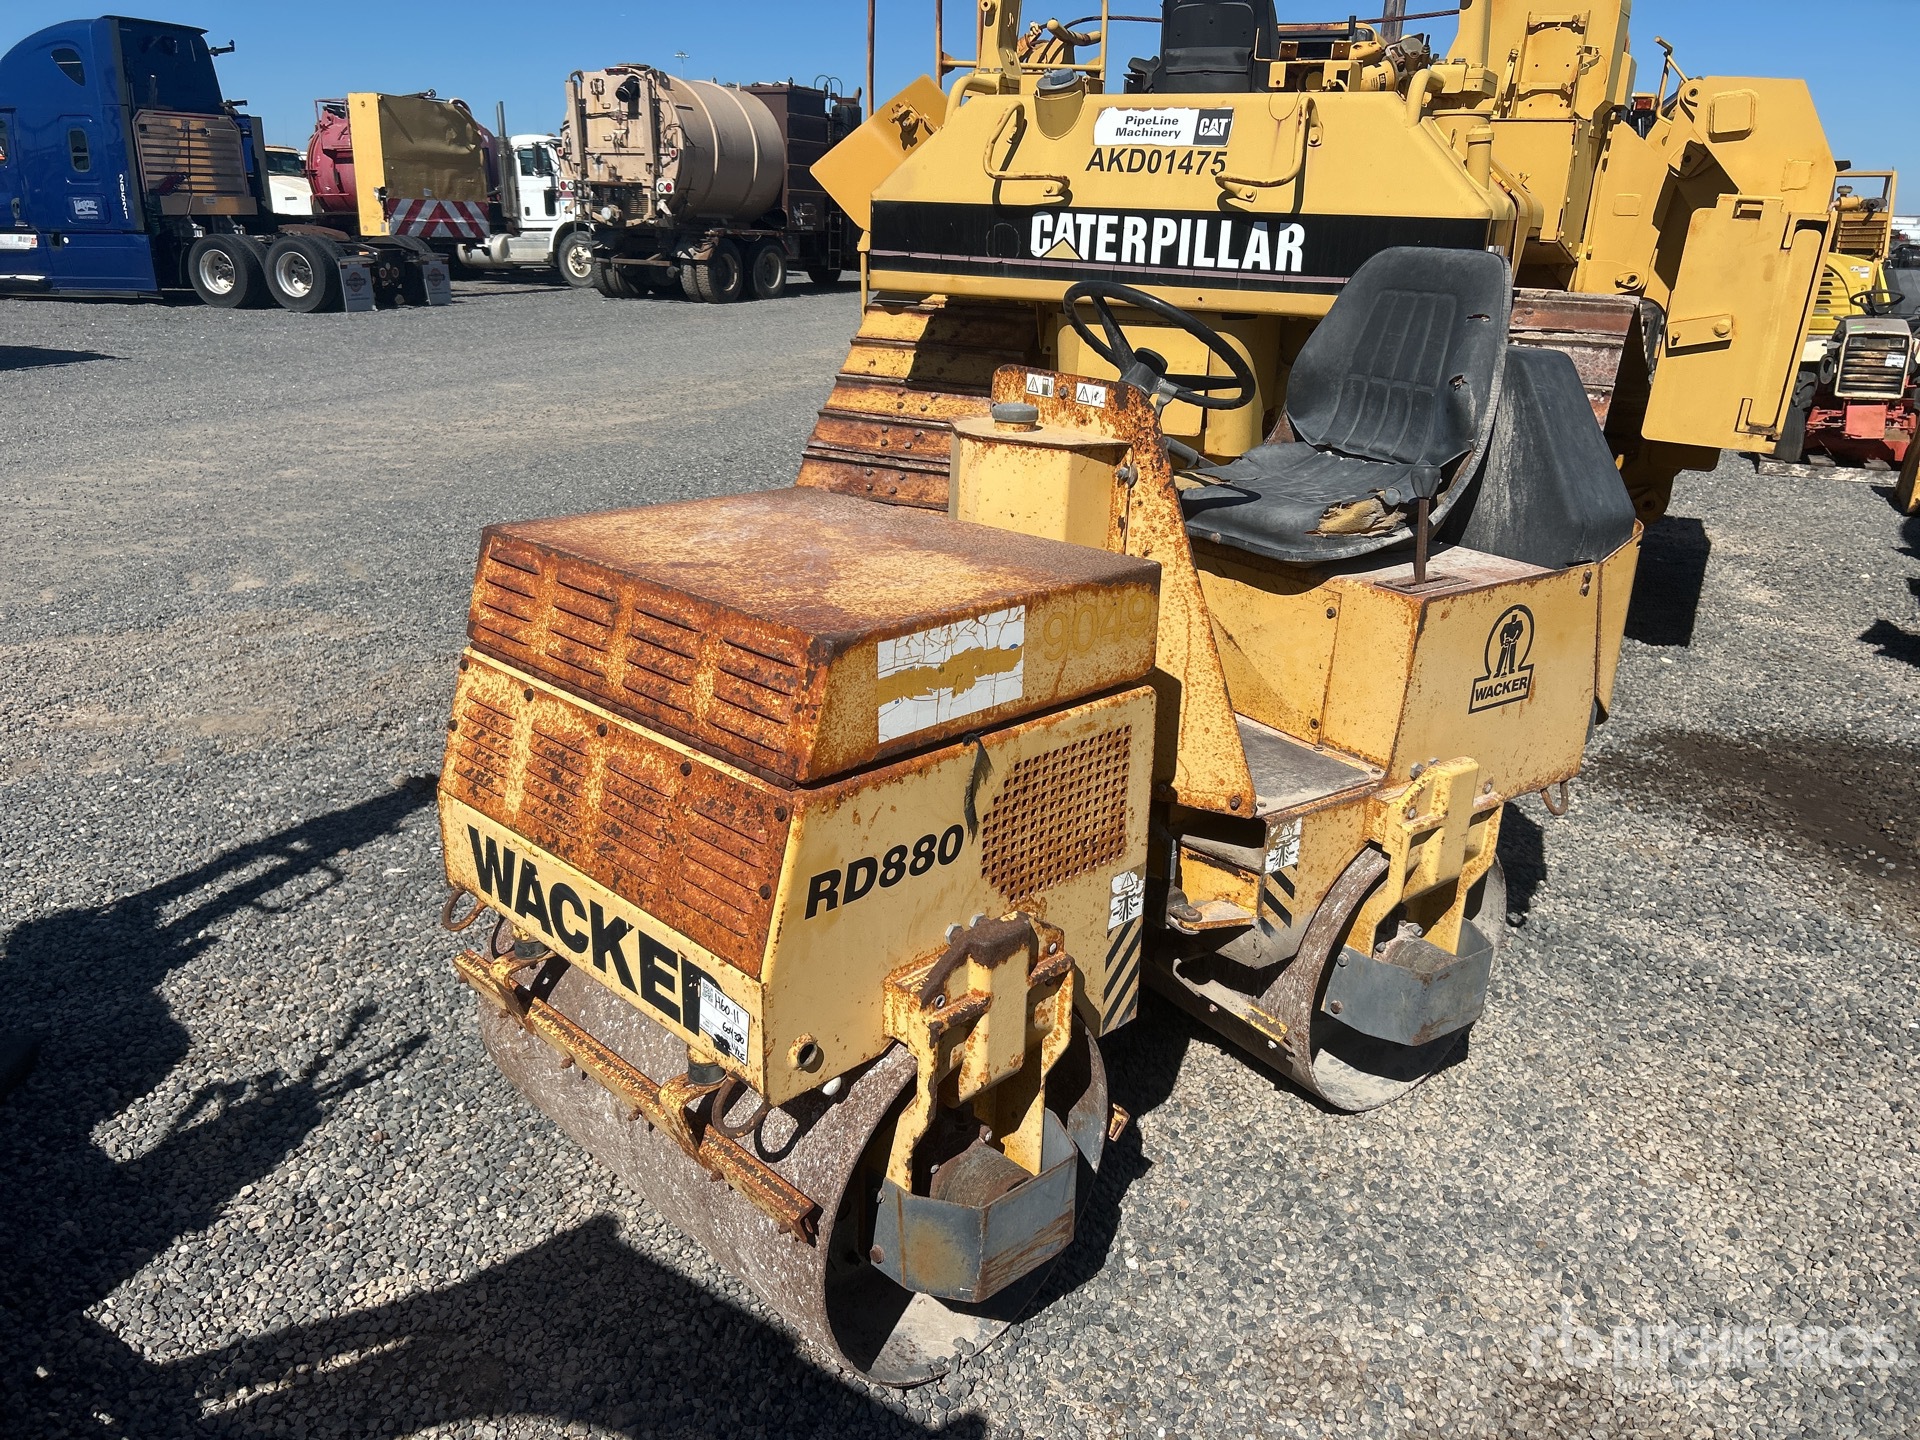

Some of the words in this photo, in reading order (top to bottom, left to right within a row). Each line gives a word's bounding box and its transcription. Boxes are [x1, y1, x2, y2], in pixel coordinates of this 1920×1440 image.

[1115, 127, 1181, 139] Machinery
[1125, 115, 1179, 126] PipeLine
[1198, 117, 1230, 136] CAT
[1085, 147, 1227, 176] AKD01475
[118, 173, 129, 220] 20521
[1029, 211, 1306, 272] CATERPILLAR
[1476, 677, 1527, 701] WACKER
[804, 824, 964, 920] RD880
